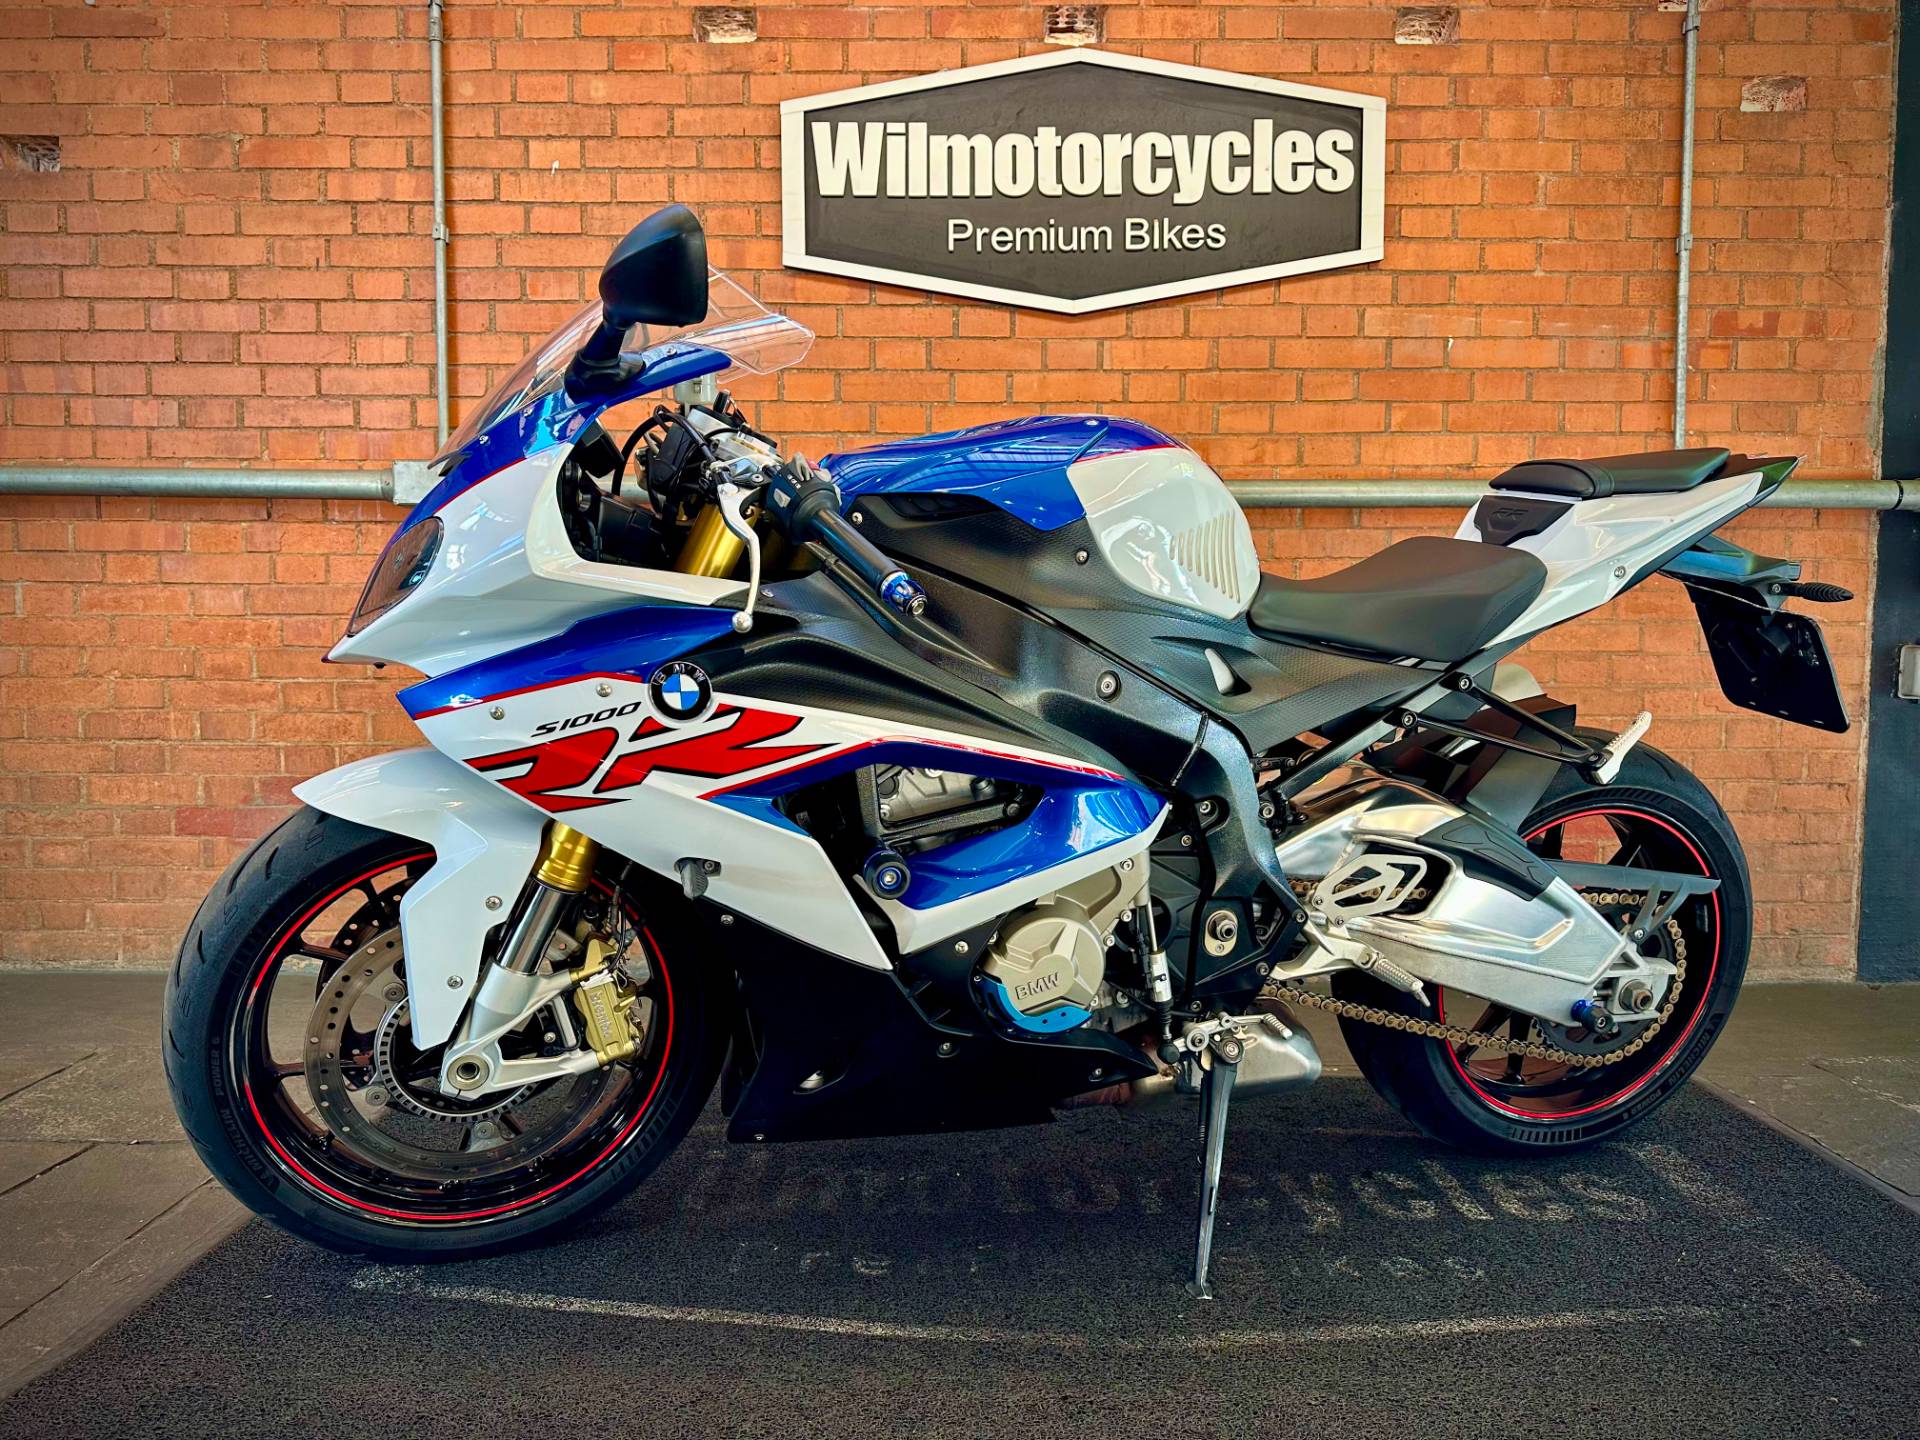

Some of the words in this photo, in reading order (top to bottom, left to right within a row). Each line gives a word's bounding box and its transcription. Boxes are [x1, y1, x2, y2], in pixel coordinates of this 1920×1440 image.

[810, 118, 1356, 205] Wilmotorcycles
[947, 218, 1113, 253] Premium
[651, 663, 706, 686] BMW
[530, 701, 642, 738] S1000
[1015, 971, 1060, 1001] BMW
[210, 1051, 225, 1097] POWER
[220, 1108, 264, 1172] MICHELIN
